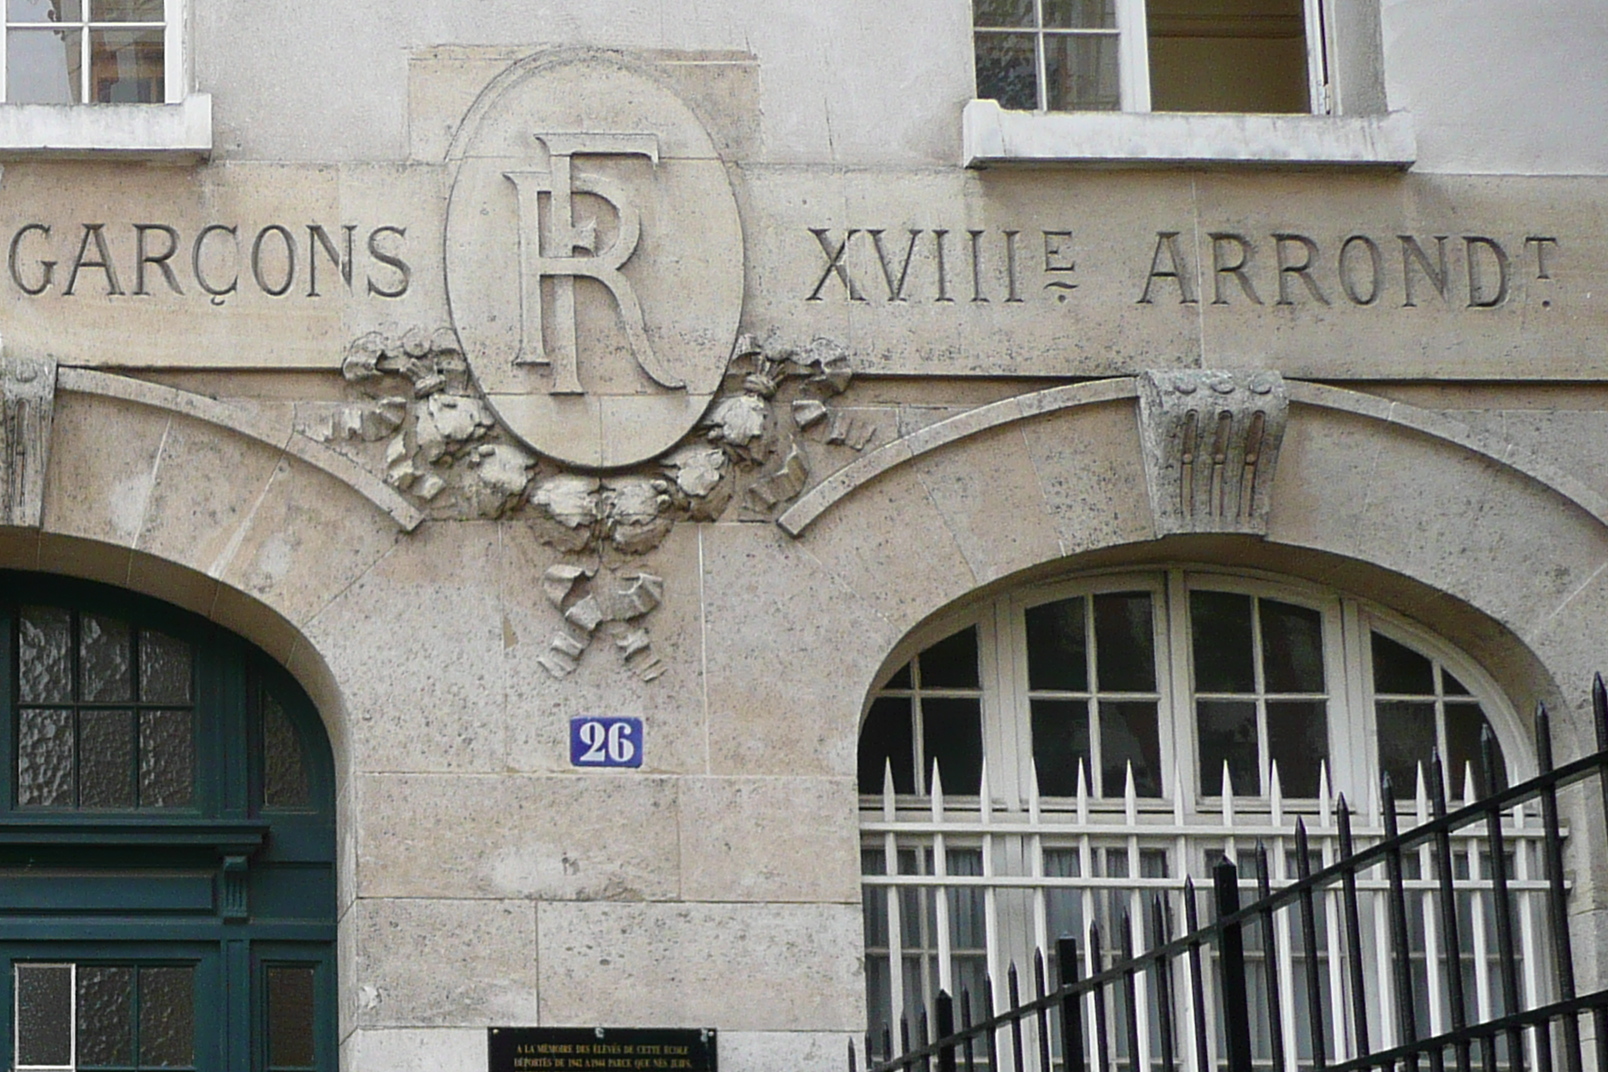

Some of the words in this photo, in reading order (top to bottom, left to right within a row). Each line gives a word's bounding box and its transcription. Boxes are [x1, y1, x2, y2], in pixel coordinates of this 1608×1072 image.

[7, 223, 410, 306] GARÇONS
[580, 722, 634, 762] 26
[524, 1044, 535, 1054] LA
[576, 1044, 590, 1054] DES
[623, 1045, 633, 1054] DE
[636, 1045, 661, 1054] CETTE
[555, 1058, 565, 1067] DE
[608, 1058, 632, 1068] PARCE
[634, 1058, 650, 1070] QUE
